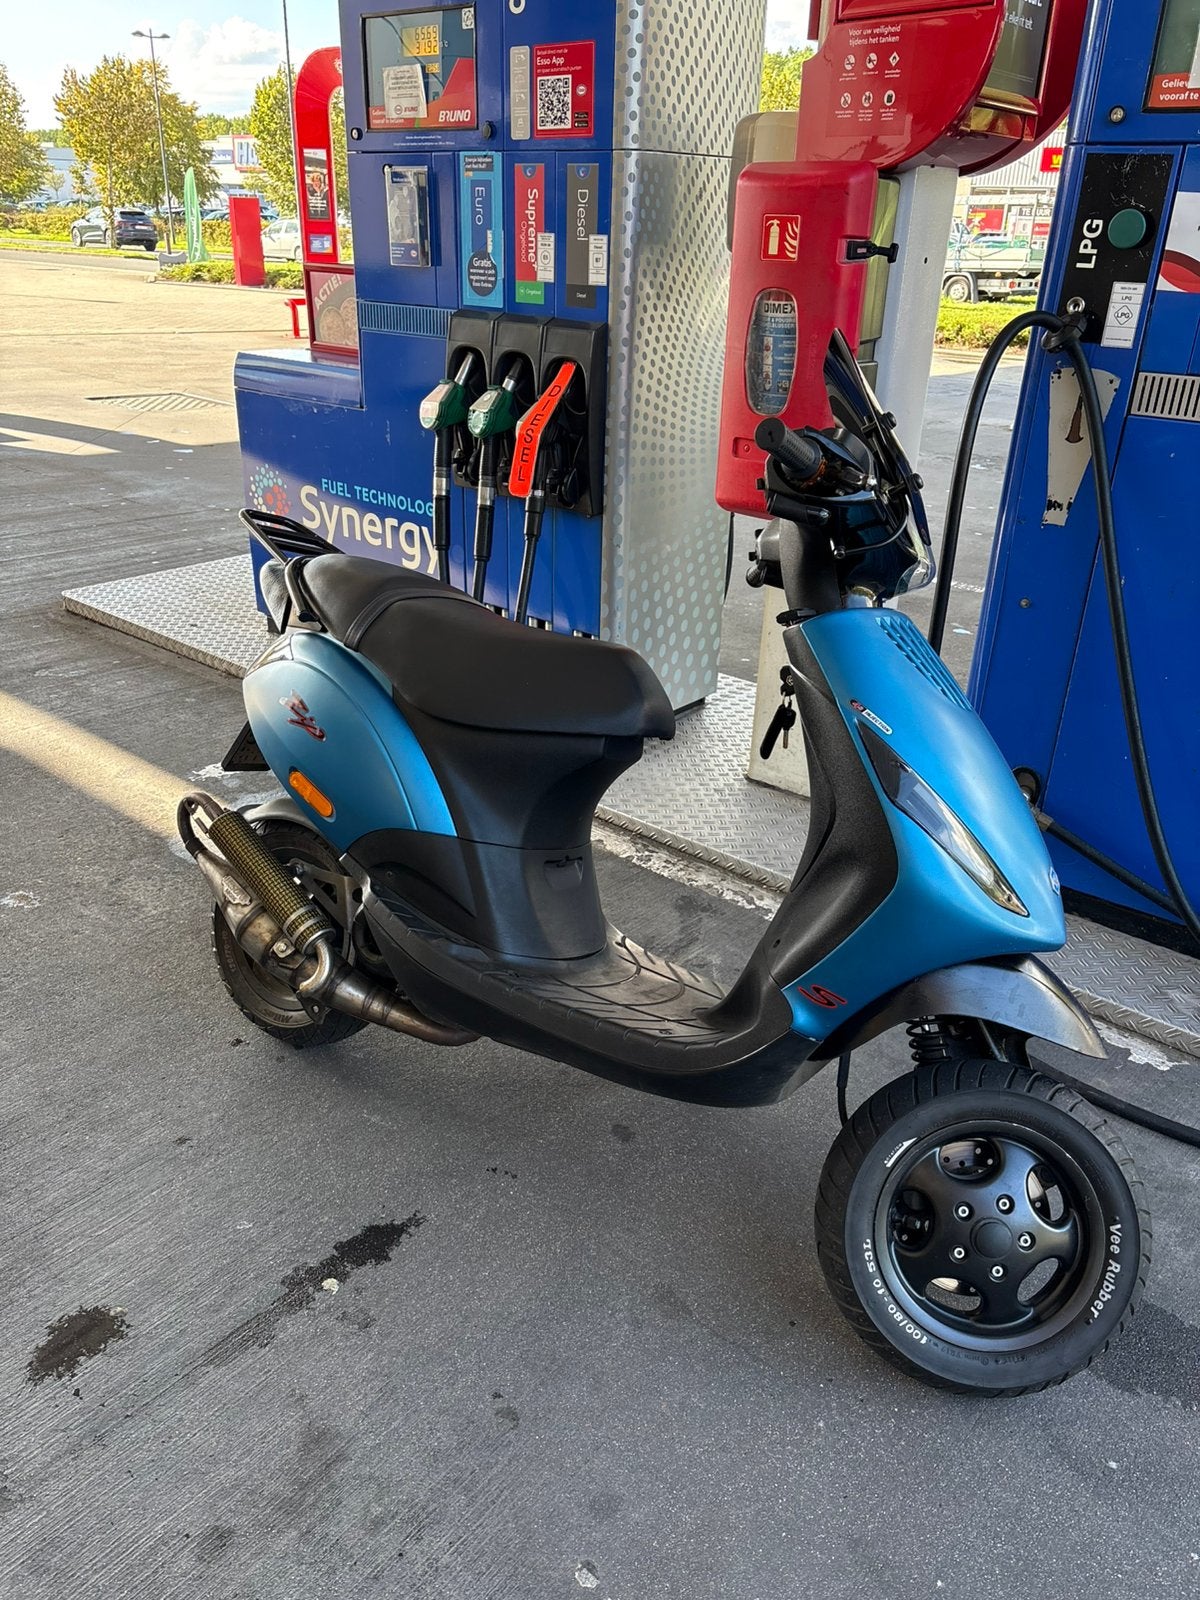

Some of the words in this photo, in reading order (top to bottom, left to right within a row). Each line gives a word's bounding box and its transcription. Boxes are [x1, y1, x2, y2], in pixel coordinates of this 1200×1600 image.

[848, 28, 862, 37] Voor
[873, 24, 901, 35] veiligheid
[849, 38, 868, 47] tijdens
[869, 36, 878, 44] het
[879, 34, 900, 43] tanken
[536, 56, 551, 66] Esso
[552, 55, 565, 66] App
[1160, 91, 1189, 101] vooraf
[1190, 92, 1199, 100] te
[438, 109, 472, 123] BRUNO
[475, 187, 486, 226] Euro
[577, 189, 589, 241] Diesel
[520, 220, 528, 263] Ongelood
[1075, 219, 1104, 269] LPG
[472, 257, 492, 267] Gratis
[314, 273, 342, 311] ACTIE!
[763, 303, 796, 314] DIMEX
[518, 384, 562, 482] DIESEL
[321, 478, 352, 498] FUEL
[354, 485, 433, 517] TECHNOLOG
[300, 485, 439, 575] Synergy
[864, 710, 892, 733] INJECTION
[1109, 1223, 1122, 1255] Vee
[1090, 1259, 1121, 1319] Rubber
